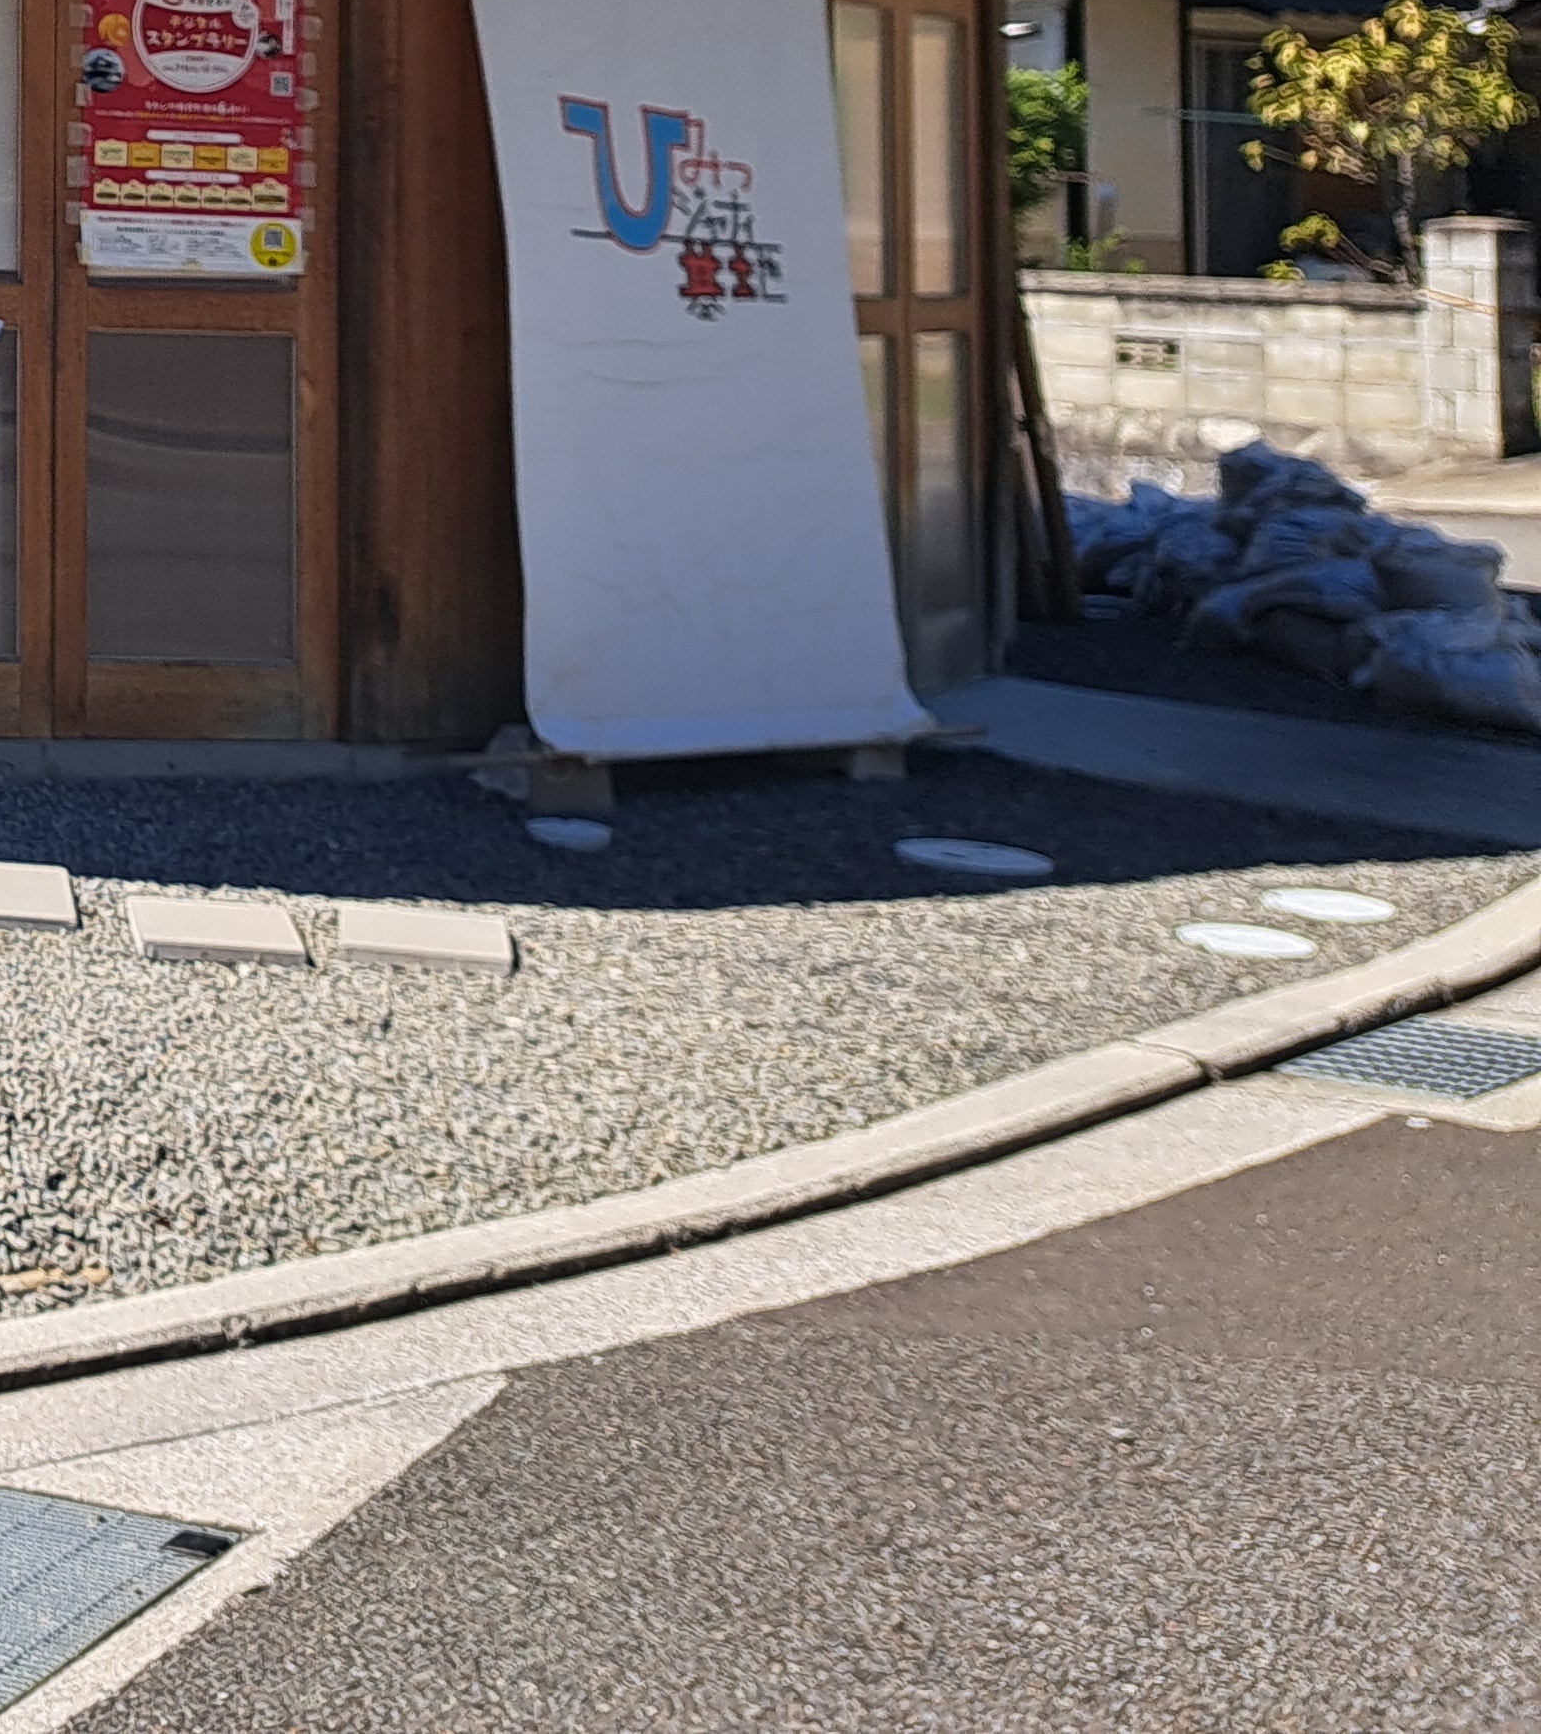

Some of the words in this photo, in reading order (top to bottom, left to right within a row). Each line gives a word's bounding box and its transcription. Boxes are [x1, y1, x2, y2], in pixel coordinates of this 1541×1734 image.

[146, 29, 248, 50] スタンプラリー
